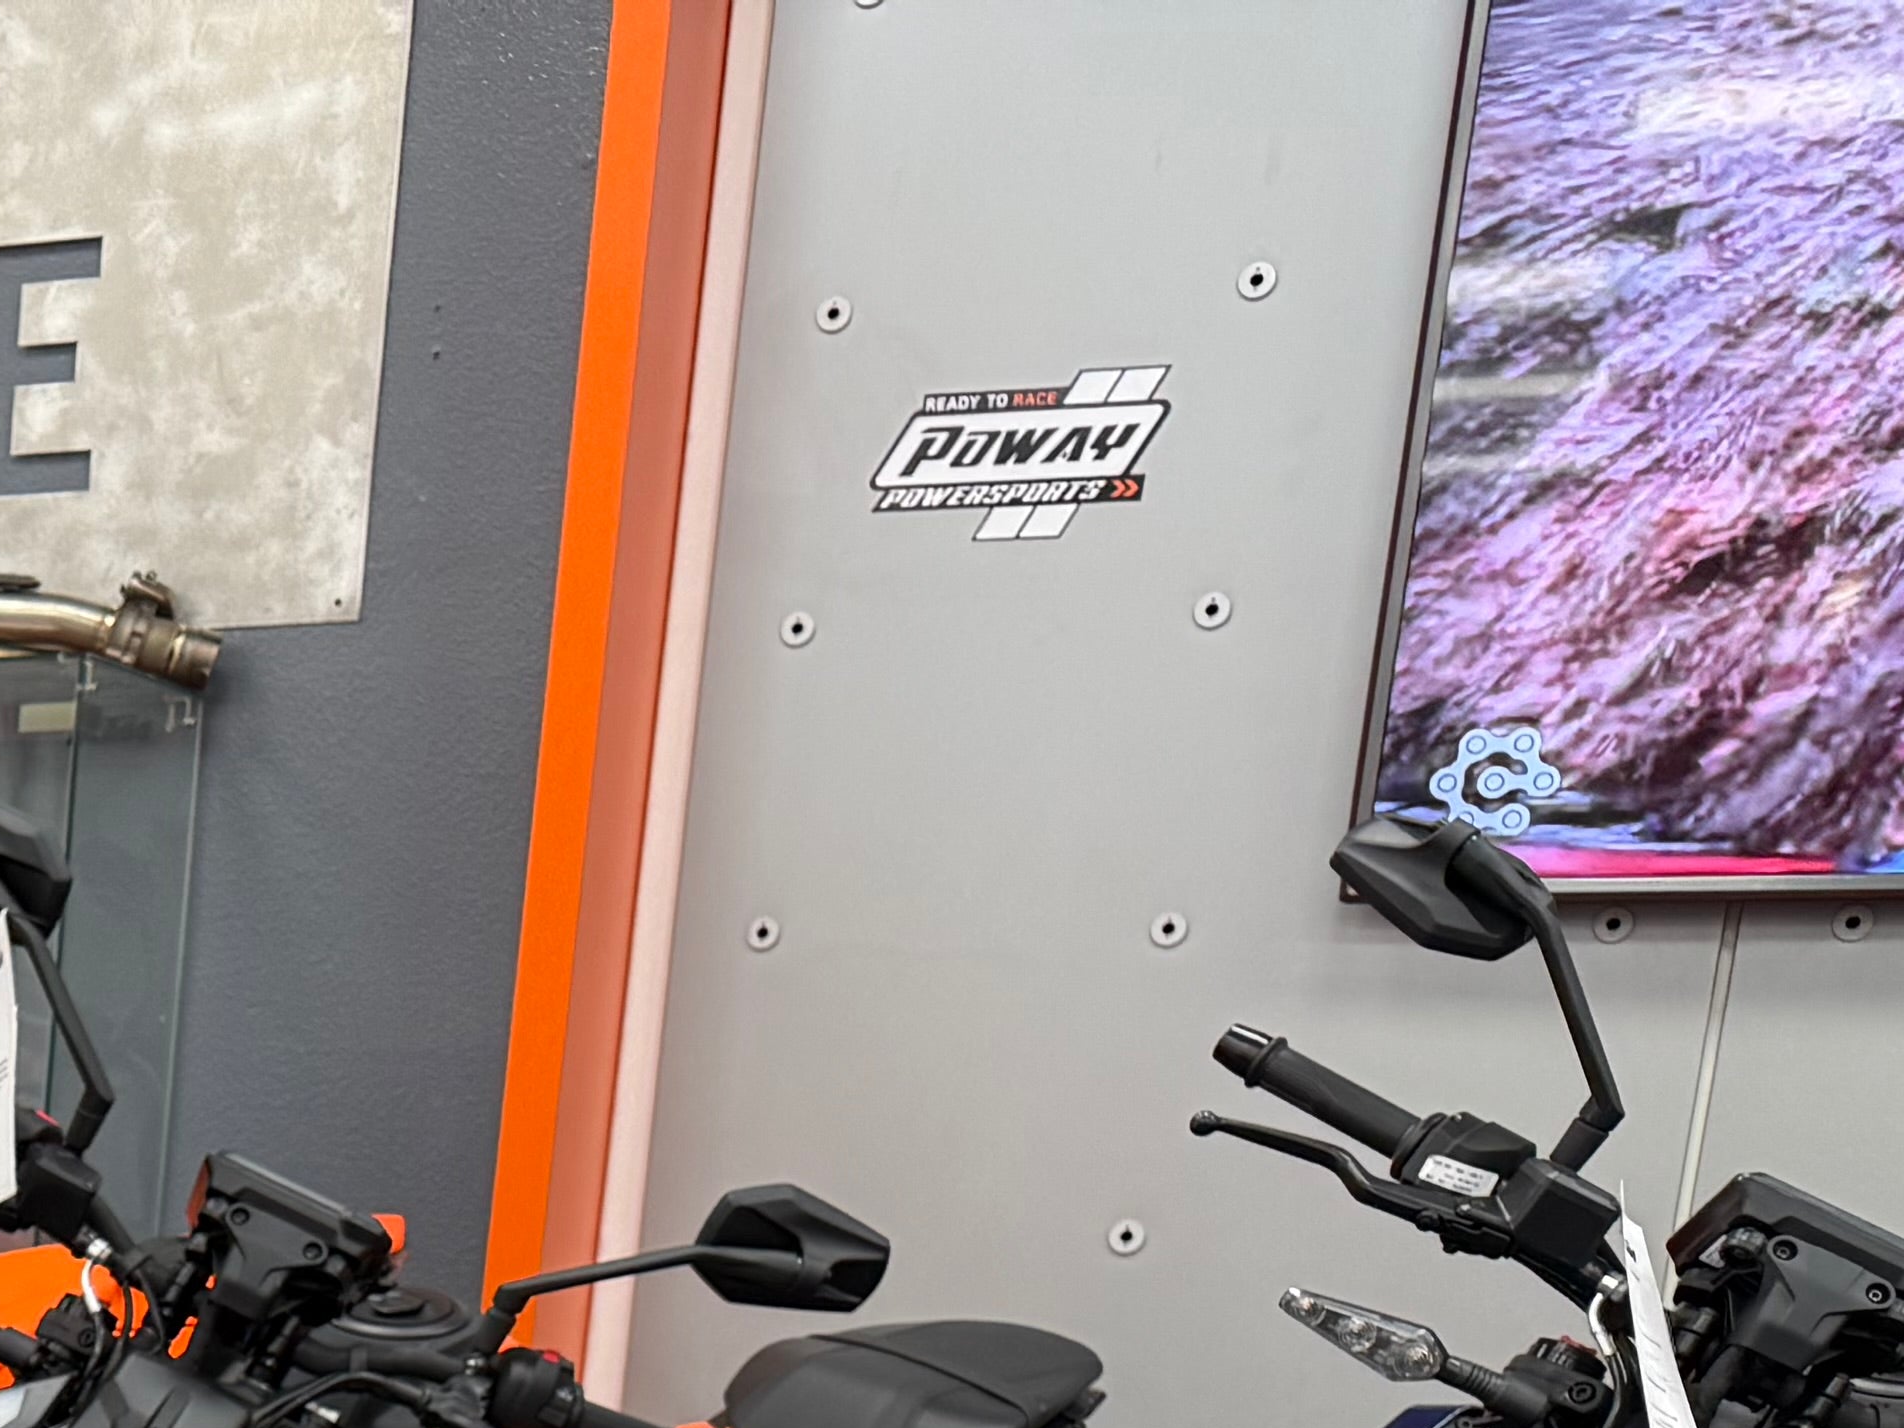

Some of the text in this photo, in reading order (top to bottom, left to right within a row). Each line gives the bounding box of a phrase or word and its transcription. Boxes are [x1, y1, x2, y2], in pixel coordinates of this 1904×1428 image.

[925, 391, 1058, 413] READY TO RACE
[879, 478, 1109, 510] POWERSPORTS
